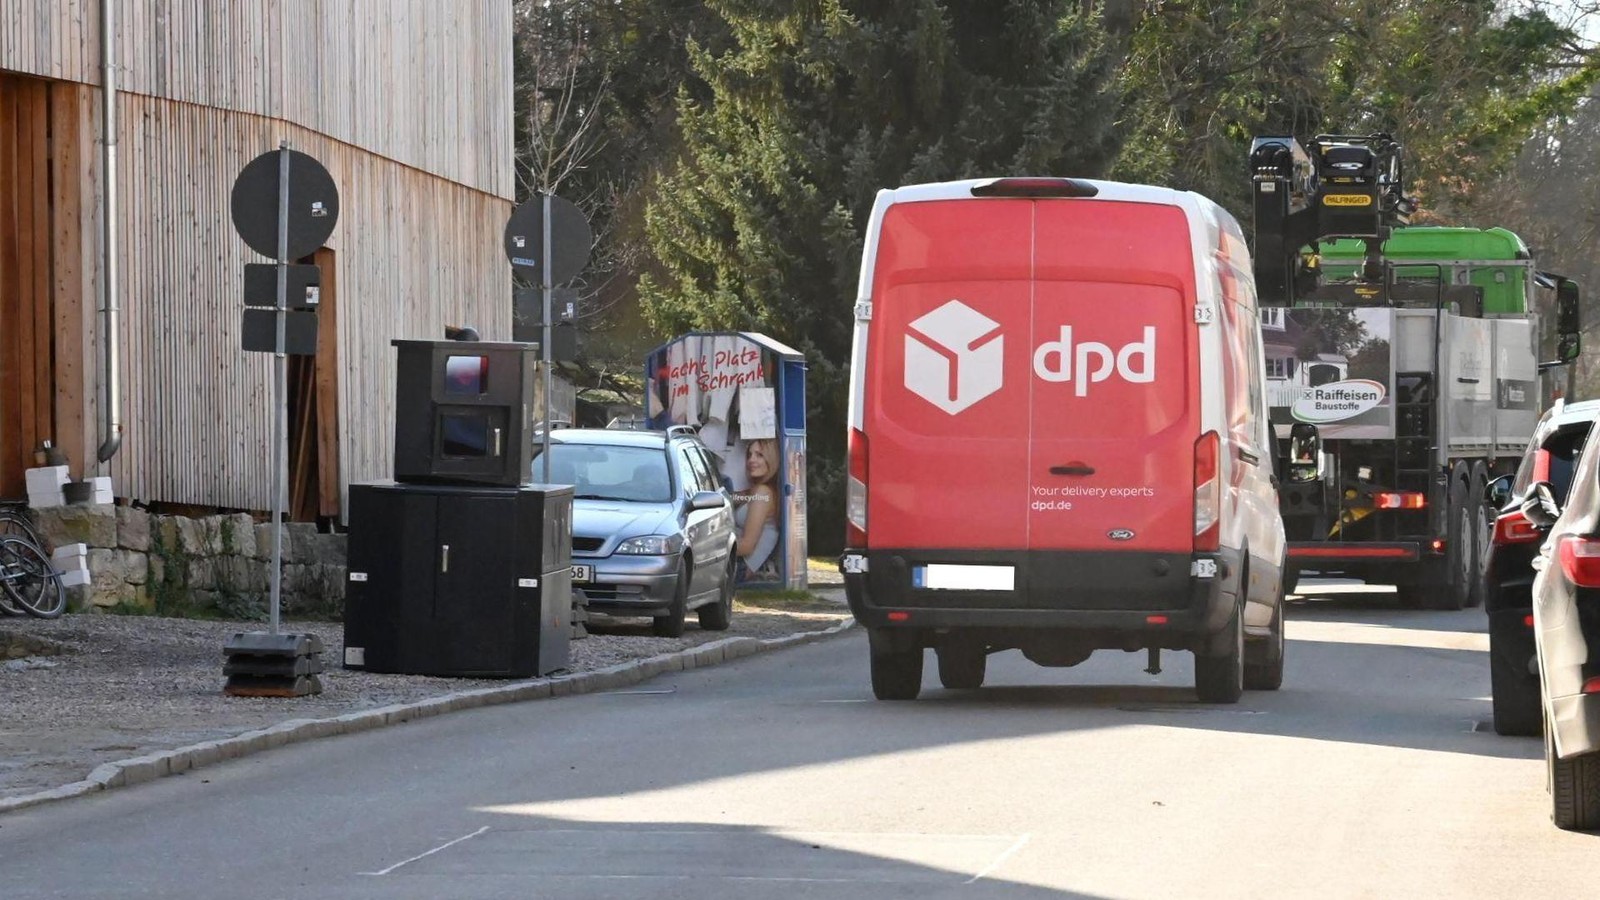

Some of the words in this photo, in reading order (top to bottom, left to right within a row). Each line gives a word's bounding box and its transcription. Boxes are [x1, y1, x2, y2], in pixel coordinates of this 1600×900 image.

[1325, 195, 1369, 204] PALFINGER
[715, 347, 759, 369] Platz
[1033, 325, 1155, 397] dpd
[671, 383, 689, 398] im
[1315, 389, 1377, 401] Raiffeisen
[1315, 401, 1360, 410] Baustoffe
[1032, 486, 1059, 496] Your
[1061, 486, 1107, 498] delivery
[1109, 486, 1154, 498] experts
[1031, 501, 1072, 511] dpd.de
